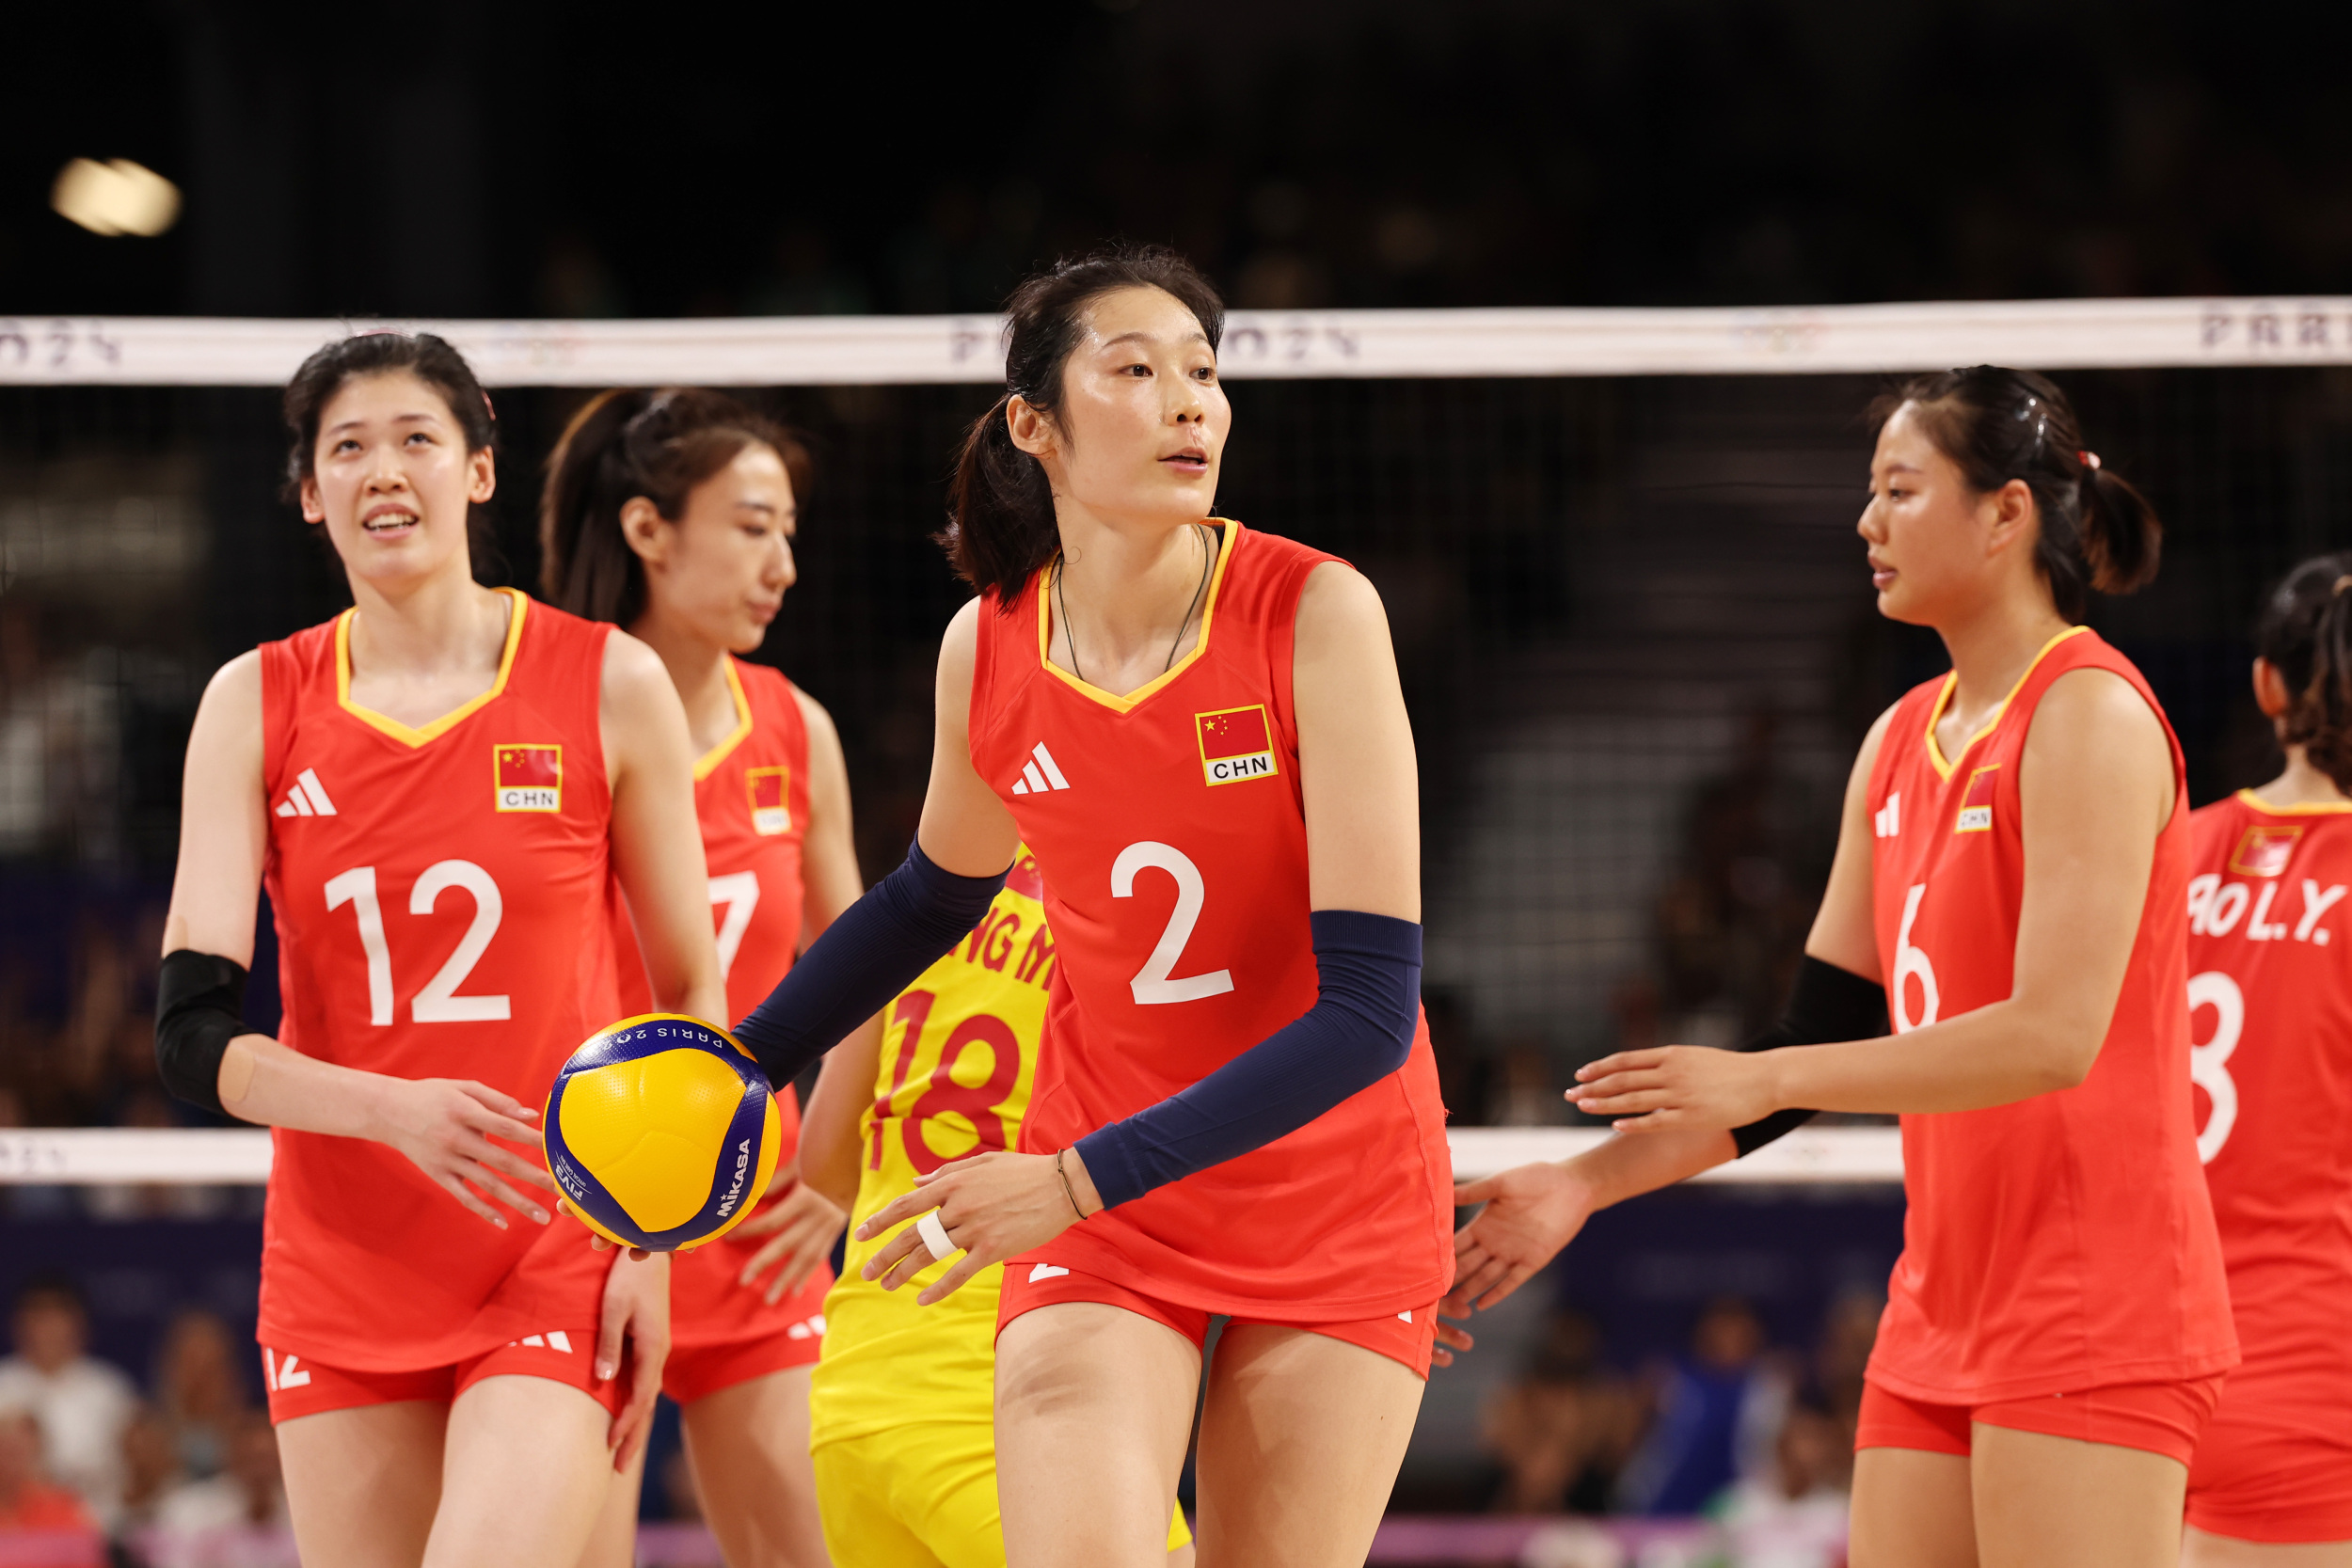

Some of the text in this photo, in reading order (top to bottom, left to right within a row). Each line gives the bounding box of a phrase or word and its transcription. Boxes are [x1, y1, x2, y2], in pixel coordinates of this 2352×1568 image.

[506, 792, 553, 806] CHN
[1214, 756, 1268, 780] CHN
[324, 859, 512, 1026] 12
[707, 869, 761, 985] 7
[1110, 840, 1234, 1005] 2
[1893, 882, 1941, 1036] 6
[656, 1027, 723, 1049] PARIS
[869, 989, 1021, 1176] 18
